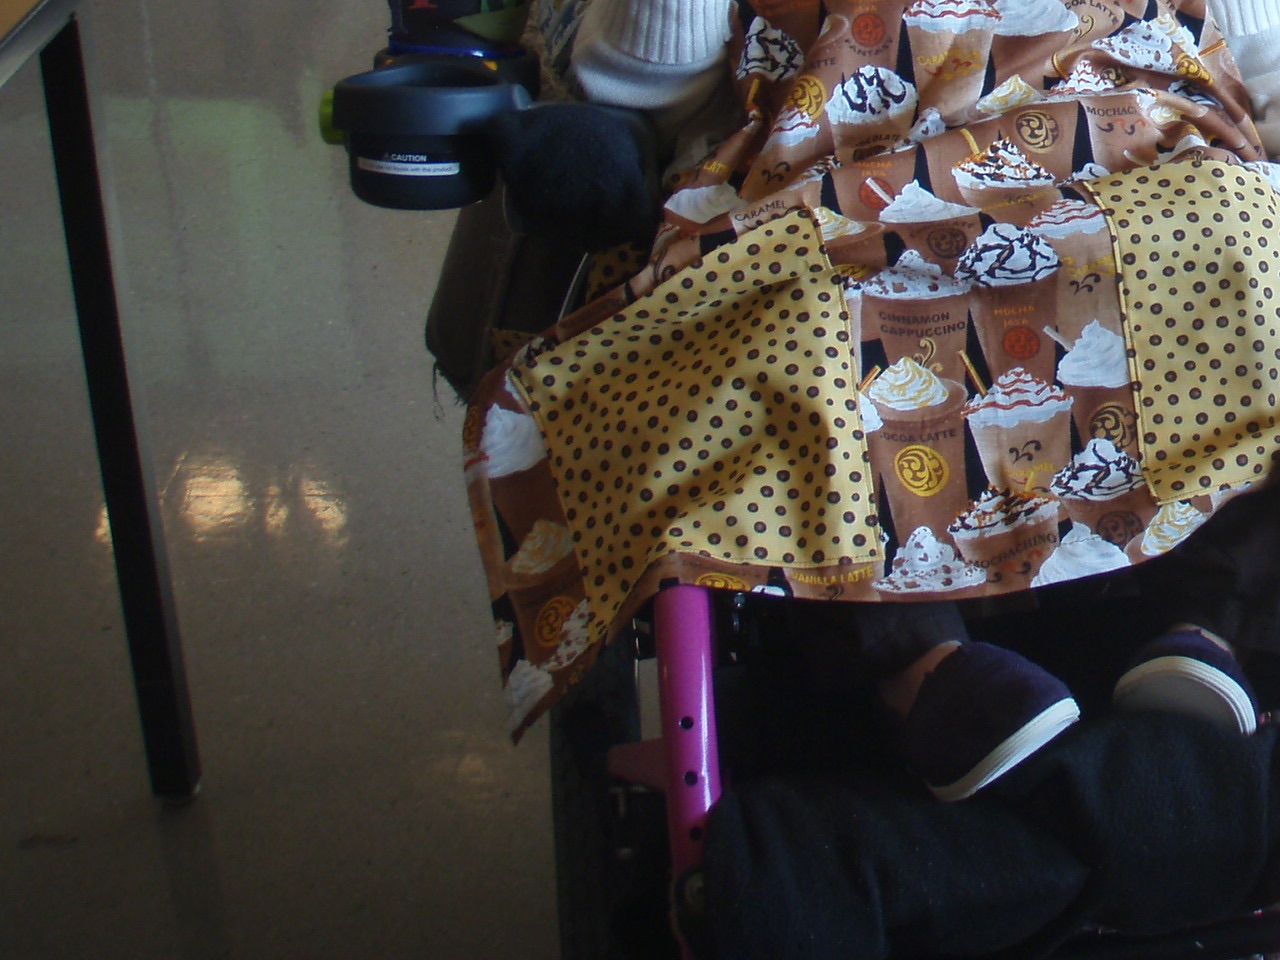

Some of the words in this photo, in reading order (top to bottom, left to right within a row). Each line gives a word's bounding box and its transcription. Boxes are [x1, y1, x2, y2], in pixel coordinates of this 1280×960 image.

[1087, 106, 1137, 116] MOCHAC
[391, 153, 427, 162] CAUTION
[734, 200, 788, 221] CARAMEL
[993, 305, 1035, 316] MOCHA
[879, 311, 950, 325] CINNAMON
[880, 321, 966, 338] CAPPUCCINO
[880, 431, 916, 442] OCOA
[919, 428, 957, 442] LATTE
[791, 571, 838, 585] VANILLA
[840, 565, 875, 583] LATTE
